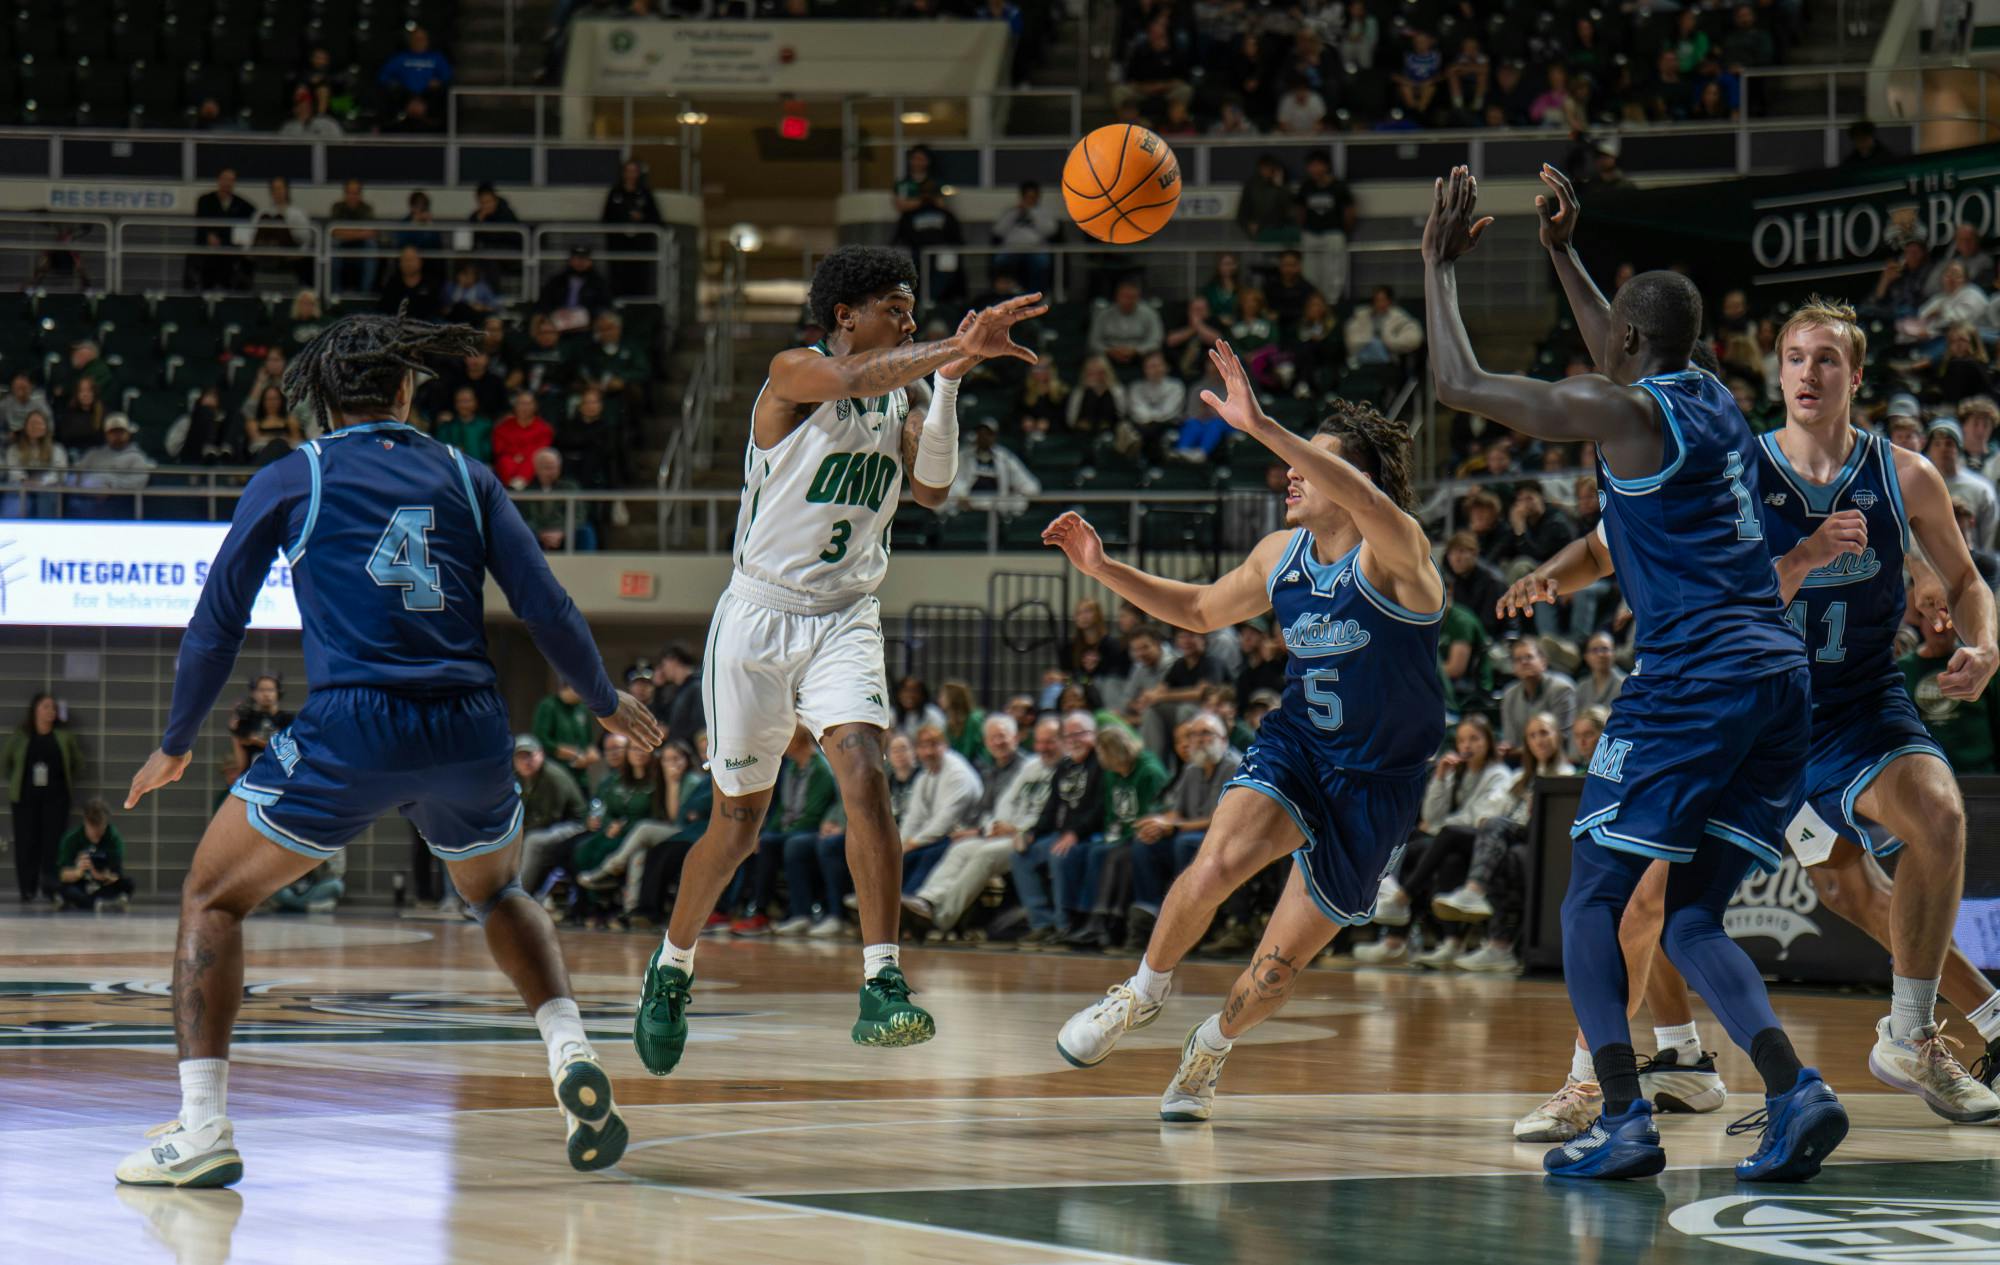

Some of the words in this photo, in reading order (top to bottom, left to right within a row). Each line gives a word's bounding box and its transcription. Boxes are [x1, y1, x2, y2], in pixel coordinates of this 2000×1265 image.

[51, 189, 175, 208] RESERVED
[1908, 169, 1956, 195] THE
[1752, 204, 1881, 268] OHIO
[805, 451, 897, 513] OHIO
[1722, 451, 1763, 540] 1
[365, 506, 444, 611] 4
[819, 519, 852, 563] 3
[72, 592, 99, 608] for
[1282, 612, 1371, 657] Maine
[1302, 668, 1344, 731] 5
[724, 754, 759, 769] Bobcats
[1587, 733, 1633, 783] M
